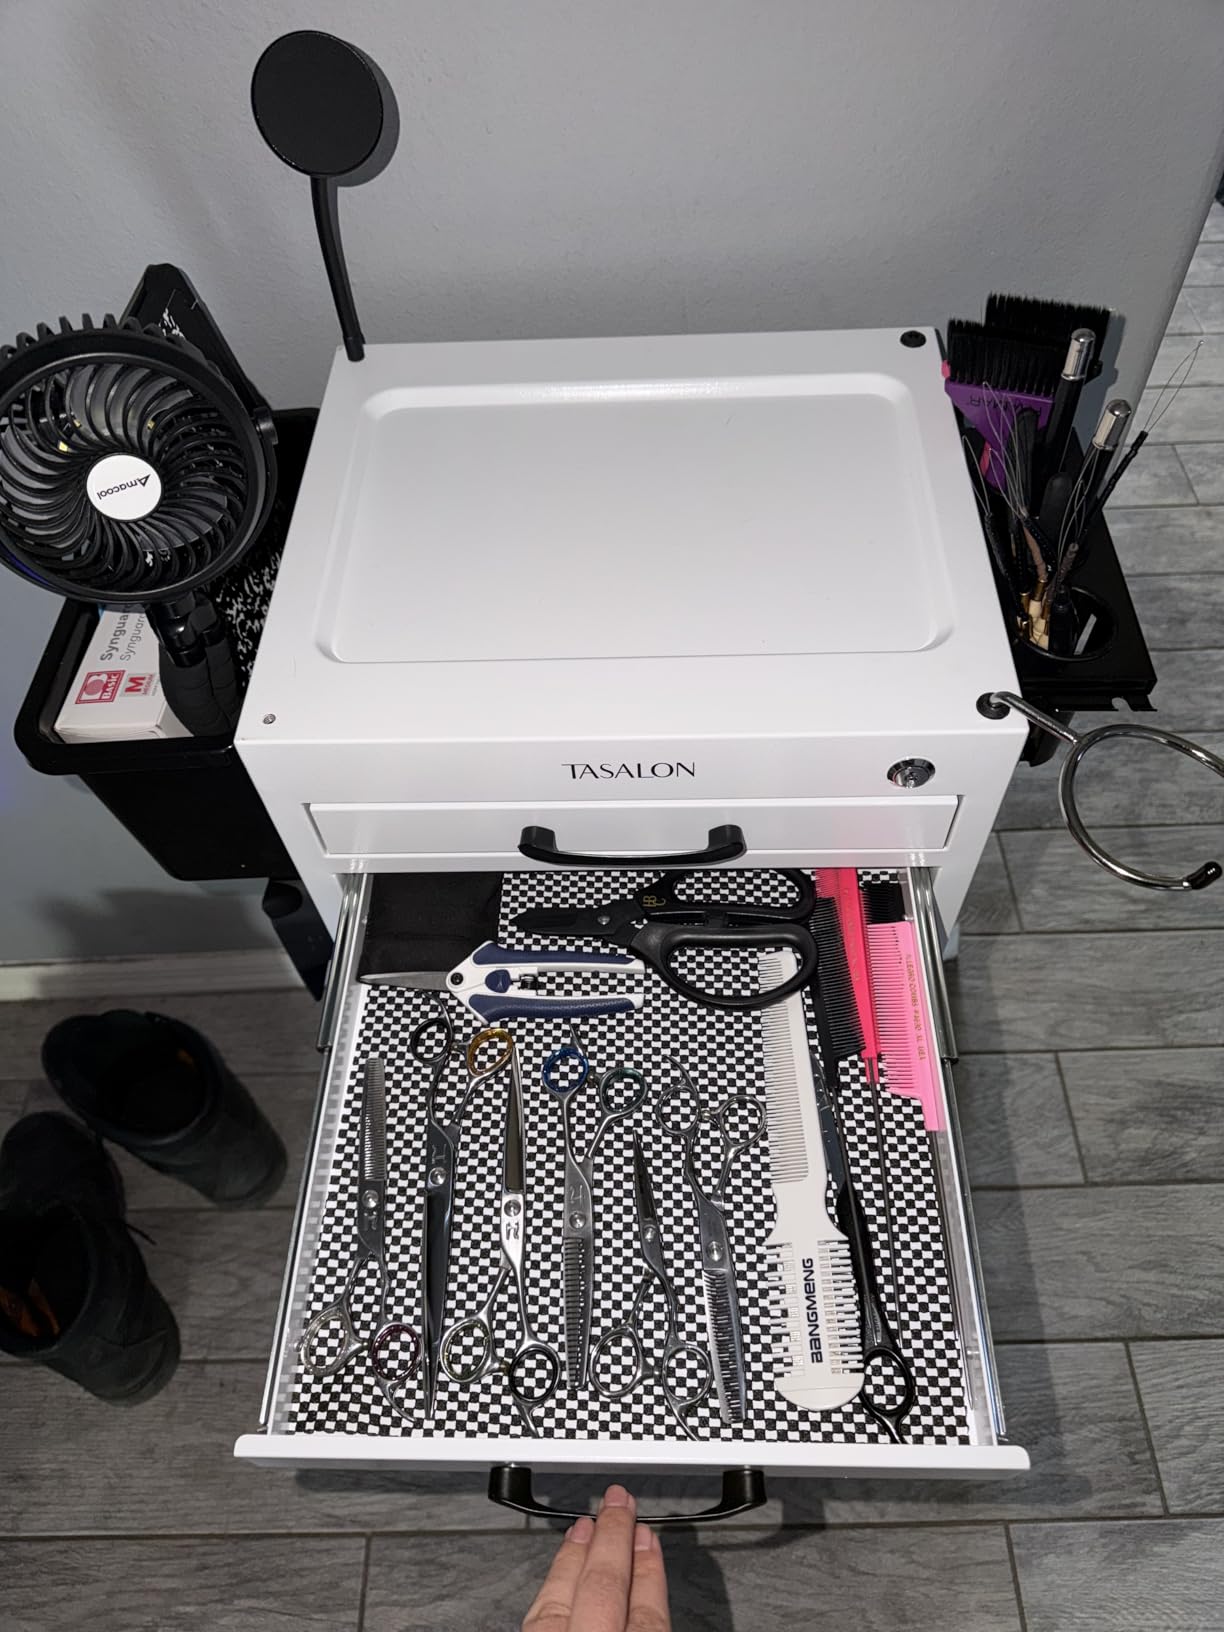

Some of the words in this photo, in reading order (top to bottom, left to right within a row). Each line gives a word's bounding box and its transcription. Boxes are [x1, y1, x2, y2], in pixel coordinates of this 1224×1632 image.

[97, 474, 151, 500] Amacool
[125, 676, 146, 693] M
[561, 762, 695, 780] TASALON
[909, 983, 919, 1007] COMBS
